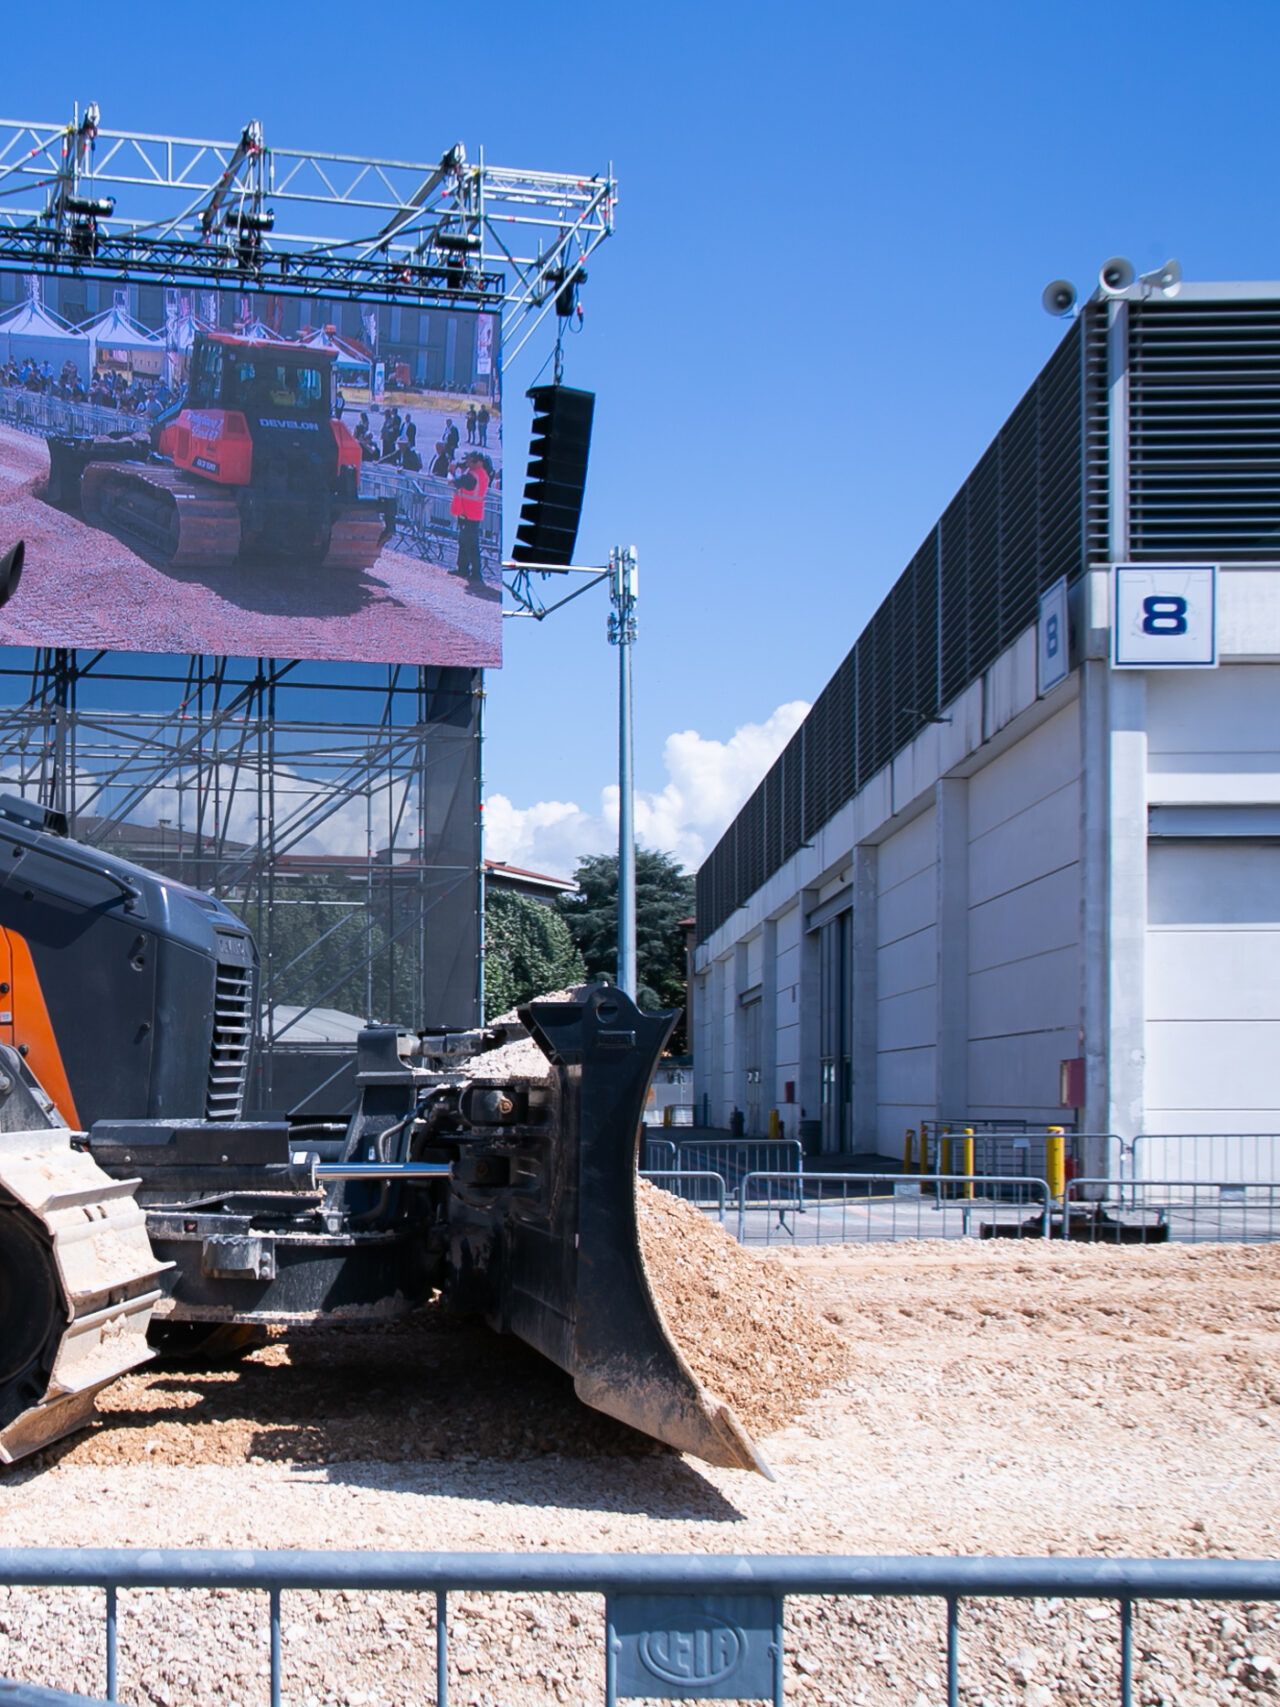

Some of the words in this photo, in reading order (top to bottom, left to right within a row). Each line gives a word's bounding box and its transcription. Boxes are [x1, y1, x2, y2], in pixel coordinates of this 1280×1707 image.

[259, 418, 320, 431] DEVELON
[1143, 595, 1188, 636] 8
[1047, 614, 1058, 659] 8
